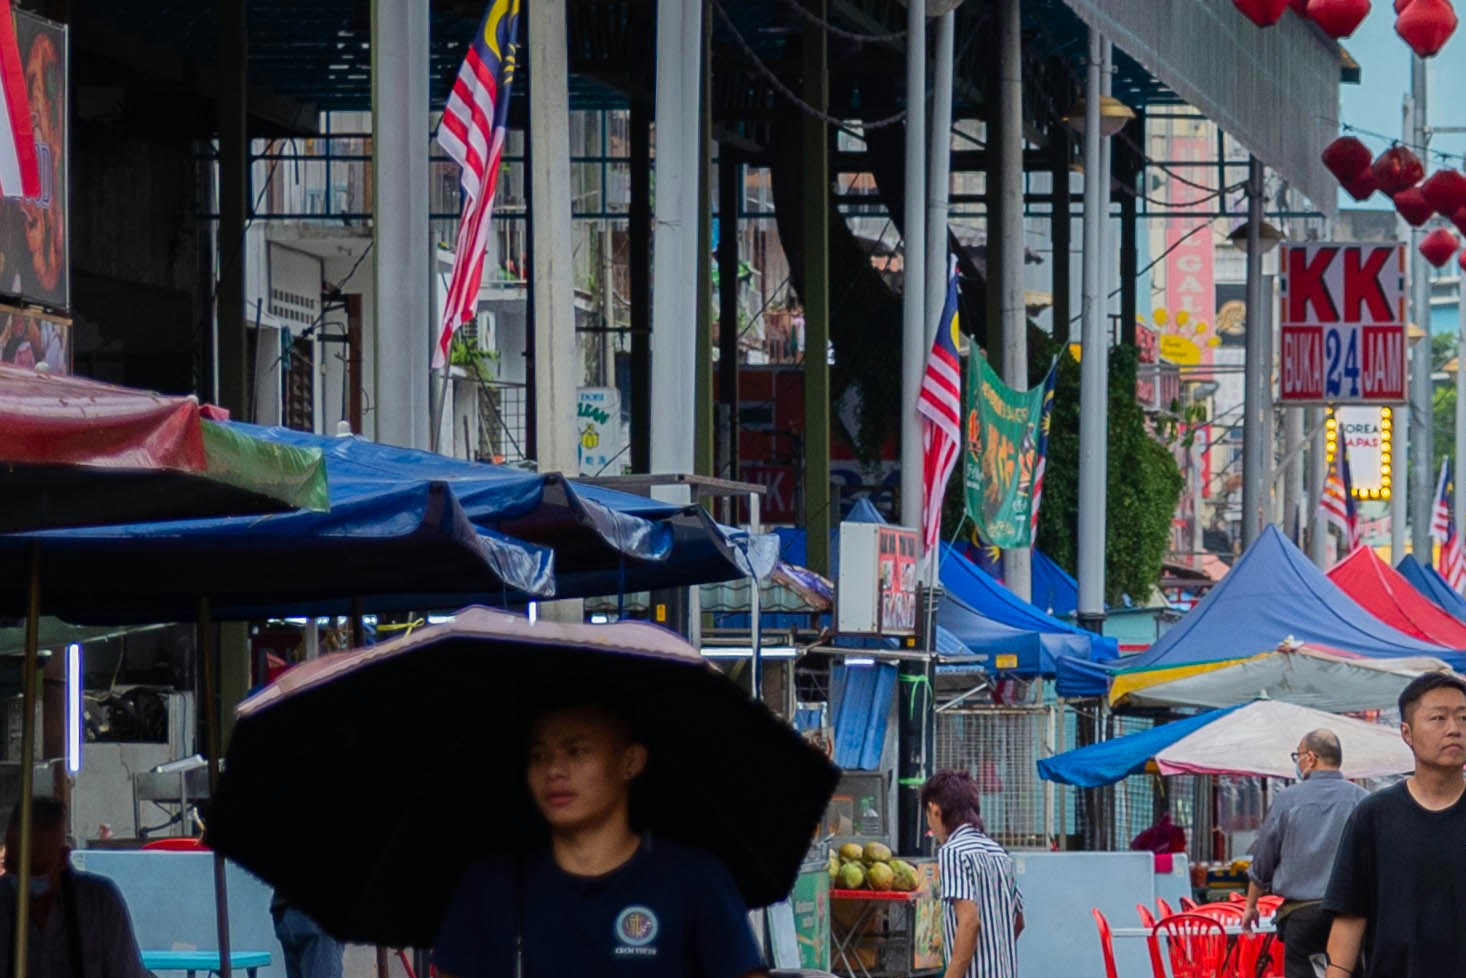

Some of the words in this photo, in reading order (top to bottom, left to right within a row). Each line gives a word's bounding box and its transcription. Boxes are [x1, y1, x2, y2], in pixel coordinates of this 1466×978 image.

[1289, 246, 1395, 323] KK
[1283, 332, 1322, 394] BUKA
[1325, 328, 1360, 398] 24
[1364, 332, 1402, 393] JAM
[1343, 423, 1379, 434] OREA
[1345, 437, 1379, 448] APAS
